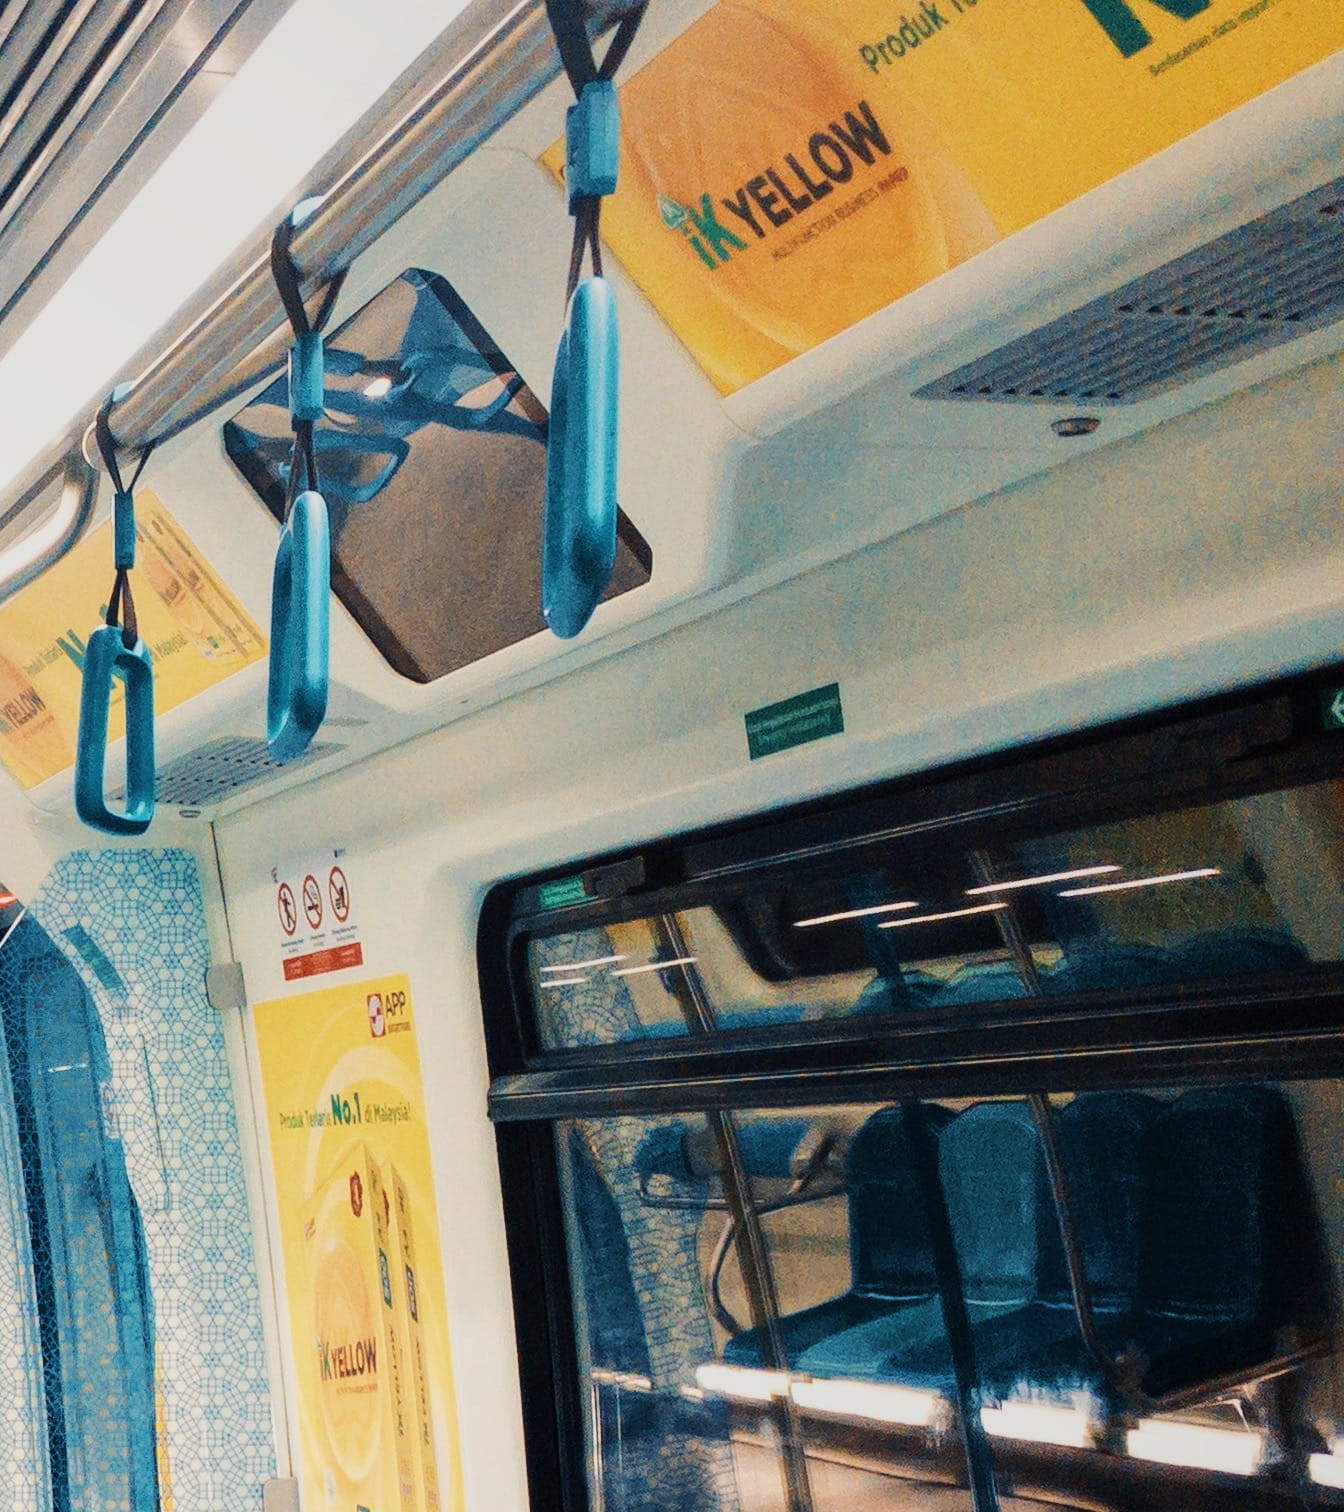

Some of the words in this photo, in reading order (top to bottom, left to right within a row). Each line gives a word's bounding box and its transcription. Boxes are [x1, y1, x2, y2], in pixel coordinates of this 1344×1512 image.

[858, 0, 950, 75] Produk
[721, 100, 891, 239] YELLOW
[2, 686, 47, 730] YELLOW
[385, 990, 406, 1018] APP
[330, 1092, 361, 1125] No.1
[330, 1336, 377, 1380] YELLOW
